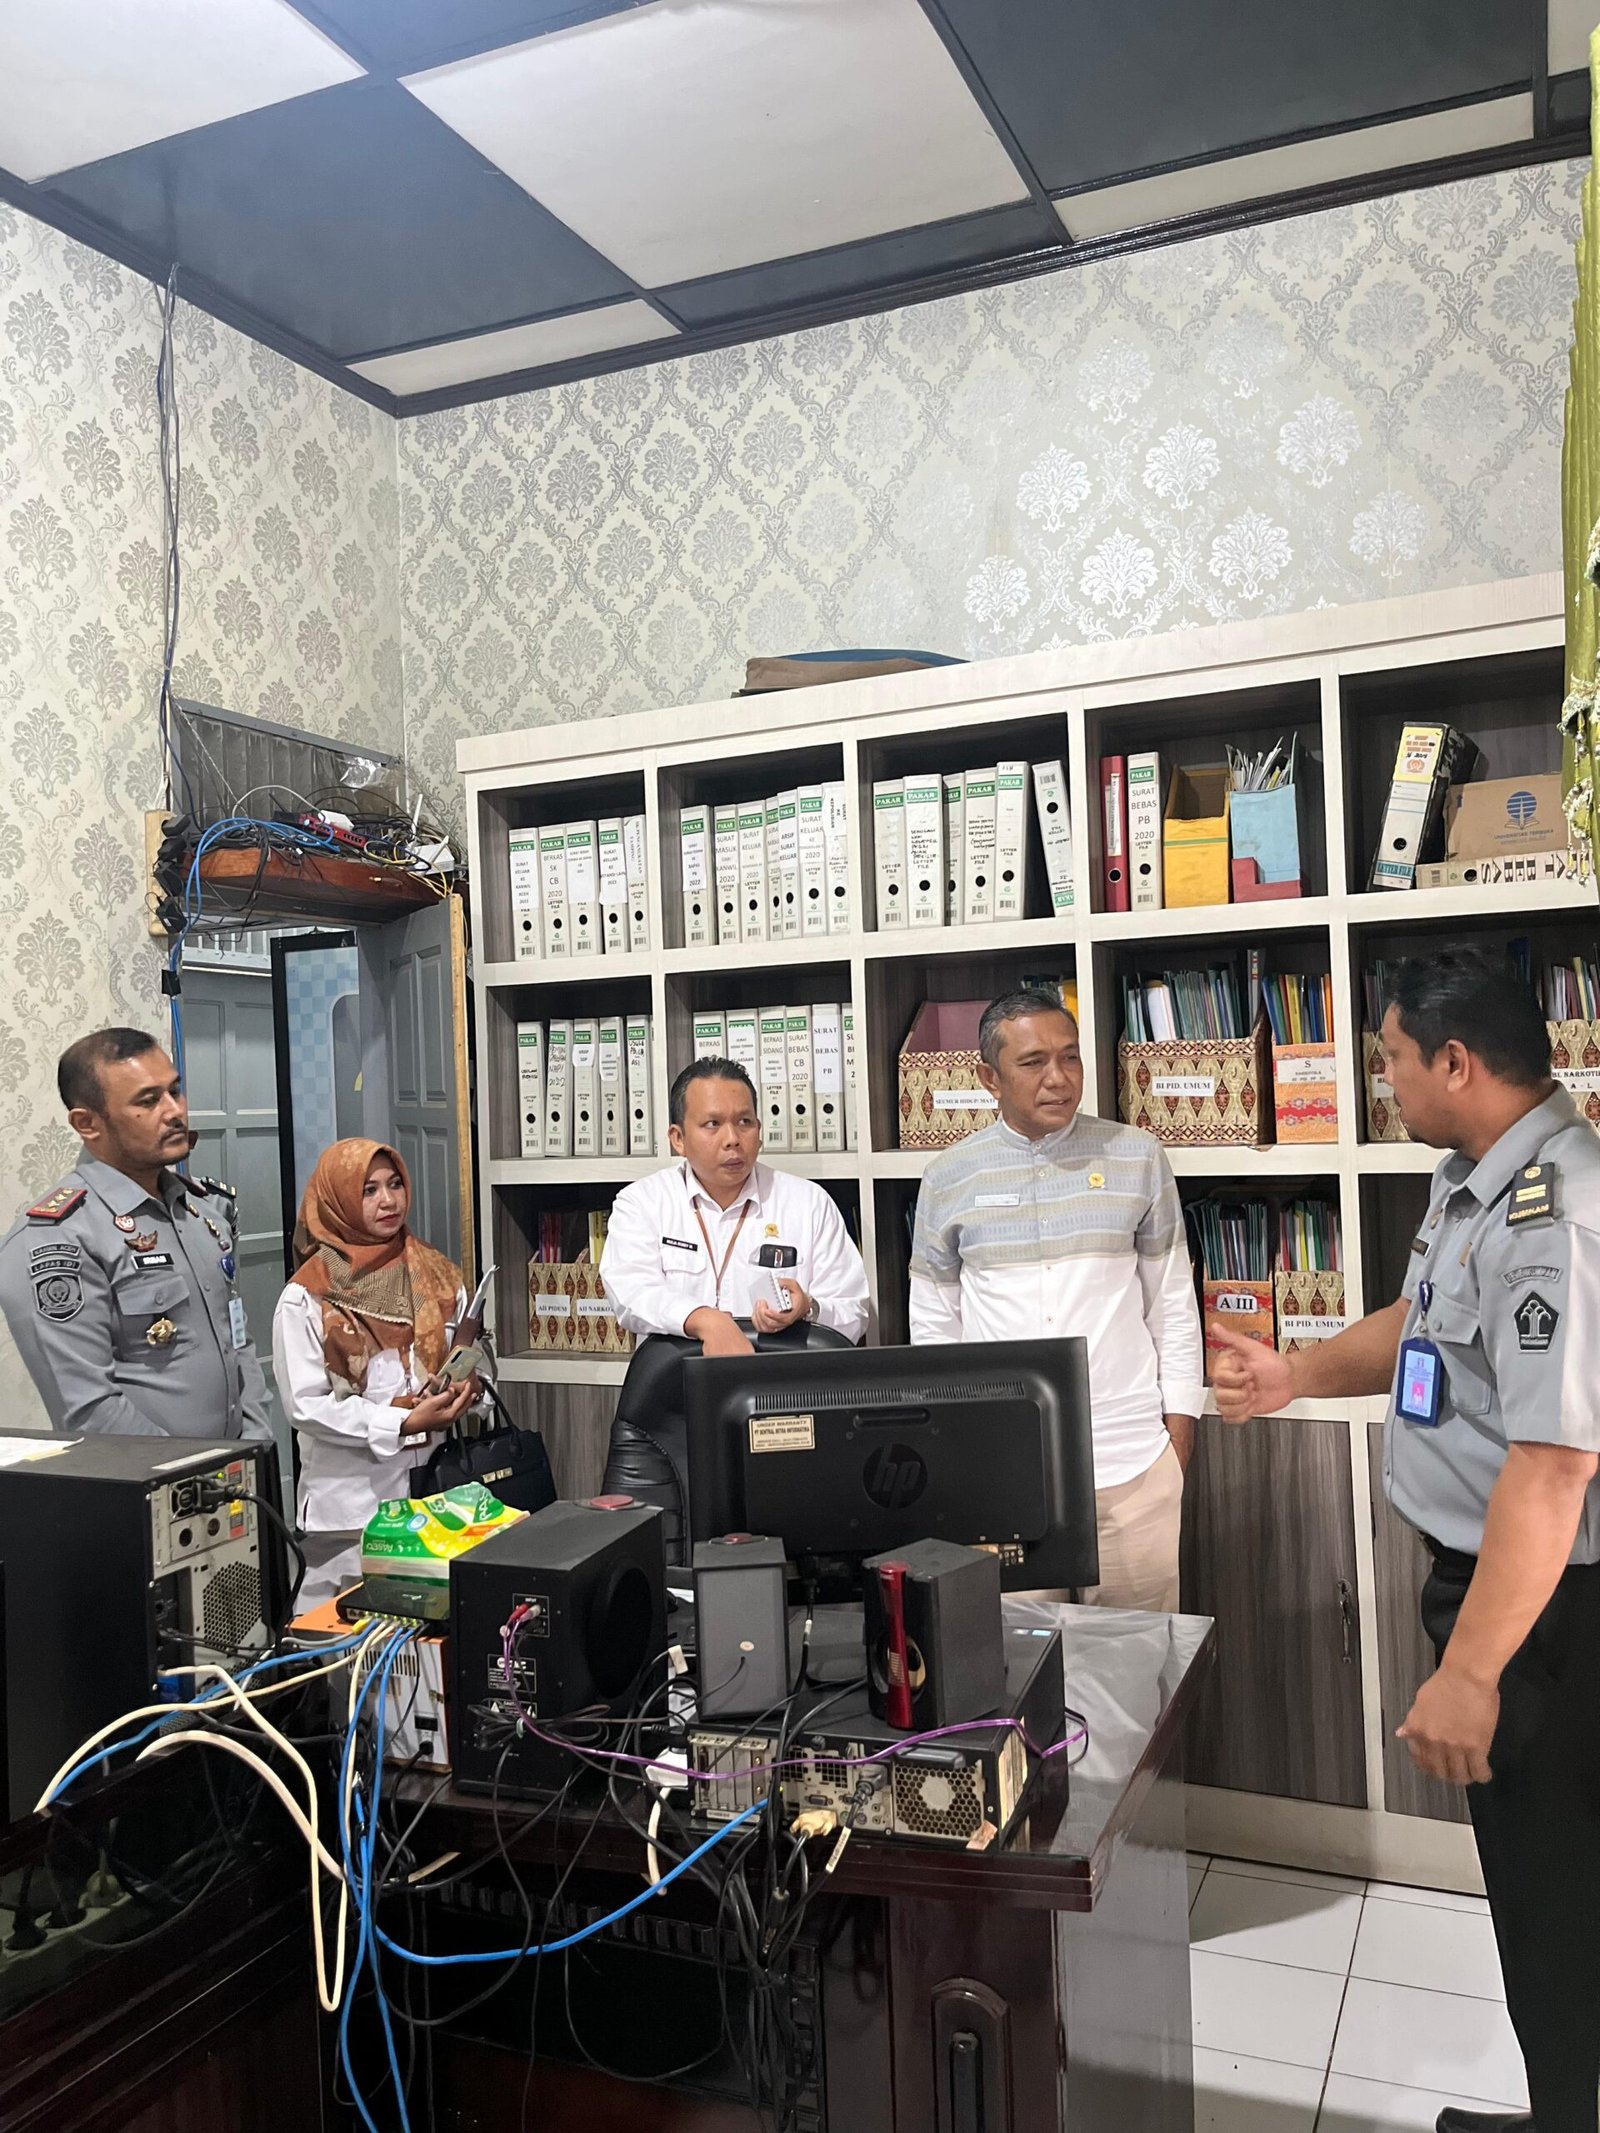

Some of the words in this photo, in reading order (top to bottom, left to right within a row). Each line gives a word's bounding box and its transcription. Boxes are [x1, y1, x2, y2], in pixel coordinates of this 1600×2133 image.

[968, 786, 992, 794] PAKAR
[1132, 788, 1155, 797] SURAT
[907, 791, 936, 799] PAKAR
[801, 800, 820, 808] PAKAR
[876, 796, 901, 805] PAKAR
[1131, 800, 1157, 810] BEBAS
[740, 817, 760, 826] PAKAR
[801, 815, 821, 824] SURAT
[1138, 815, 1150, 824] PB
[683, 823, 702, 832] PAKAR
[717, 835, 735, 843] SURAT
[743, 831, 759, 839] SURAT
[781, 832, 794, 840] ARSIP
[1135, 831, 1155, 840] 2020
[568, 836, 589, 844] PAKAR
[715, 846, 737, 854] MASUK
[742, 843, 761, 851] KELUAR
[780, 842, 795, 850] SURAT
[780, 853, 797, 861] KELUAR
[805, 851, 821, 859] 2020
[719, 875, 735, 883] 2020
[746, 871, 759, 879] 2020
[549, 877, 559, 885] CB
[548, 890, 562, 898] 2020
[788, 1046, 810, 1054] BEBAS
[794, 1059, 805, 1067] CB
[1304, 1060, 1312, 1068] S
[792, 1073, 809, 1081] 2020
[34, 1260, 61, 1271] LAPAS
[1220, 1300, 1231, 1309] A
[1236, 1298, 1253, 1310] III
[870, 1443, 922, 1508] hp
